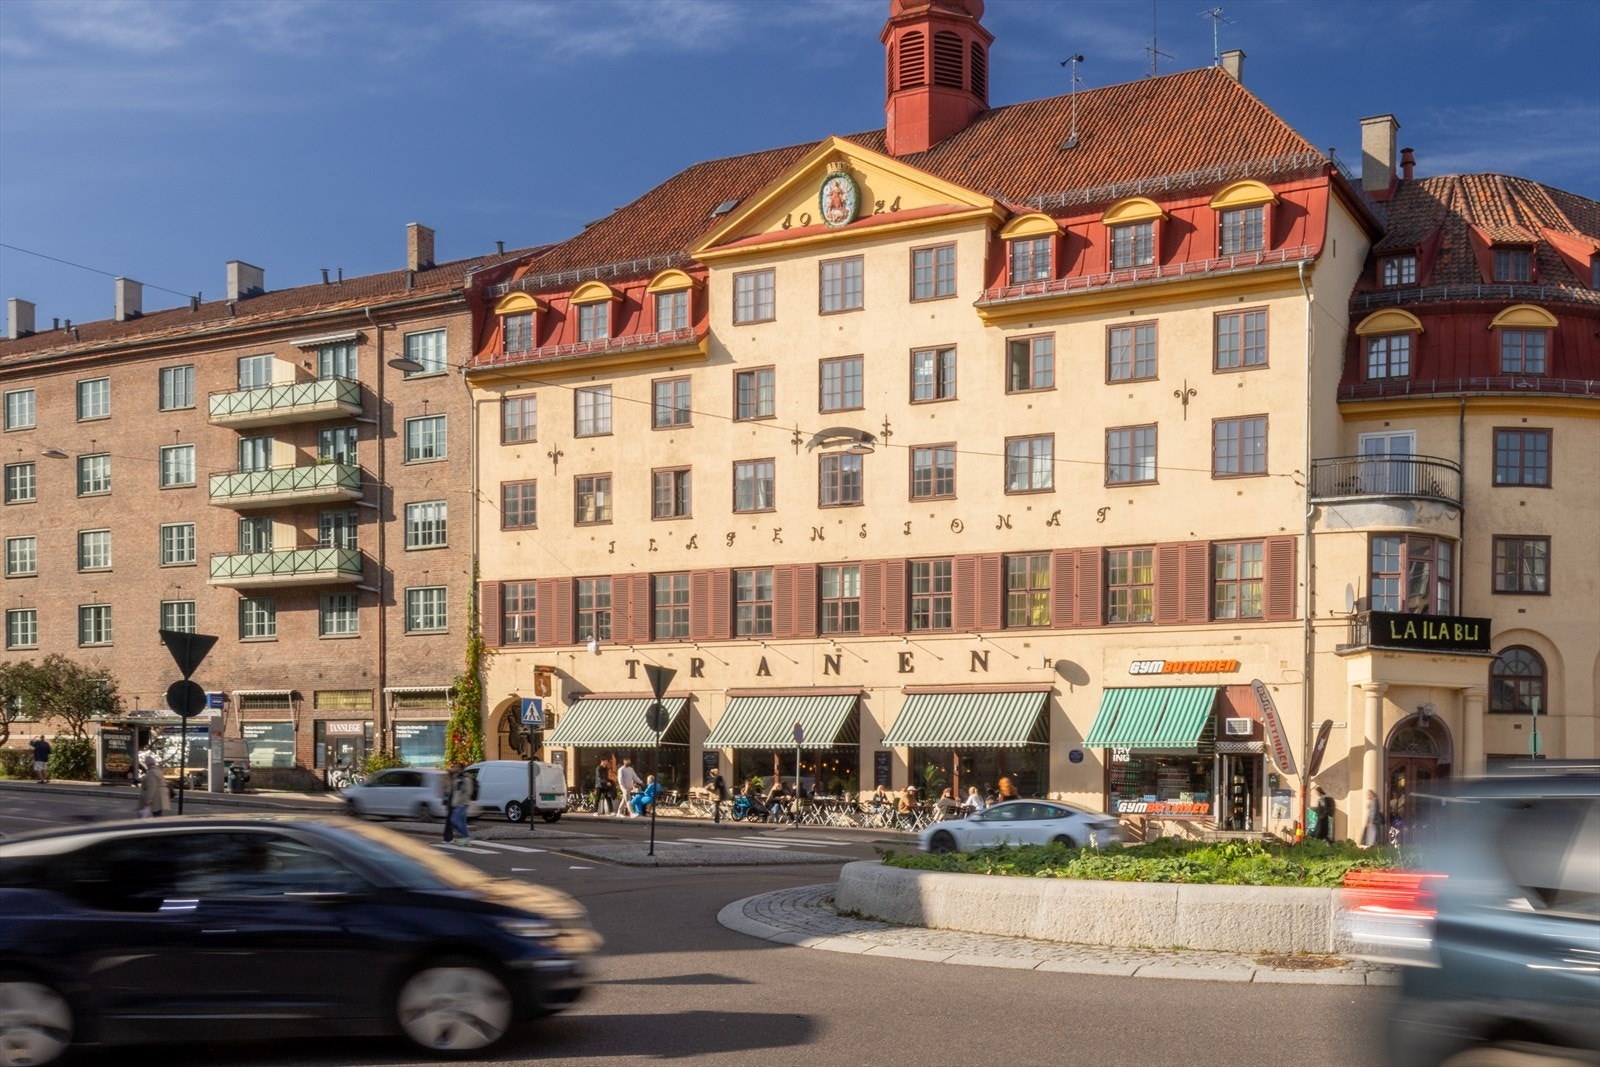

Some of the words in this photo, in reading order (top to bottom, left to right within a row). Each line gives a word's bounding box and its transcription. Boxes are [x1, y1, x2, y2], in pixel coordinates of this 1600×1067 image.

[1390, 620, 1417, 639] LA
[1454, 623, 1479, 641] BLI
[625, 650, 990, 679] TRANEN
[329, 723, 361, 733] TANNLEGE
